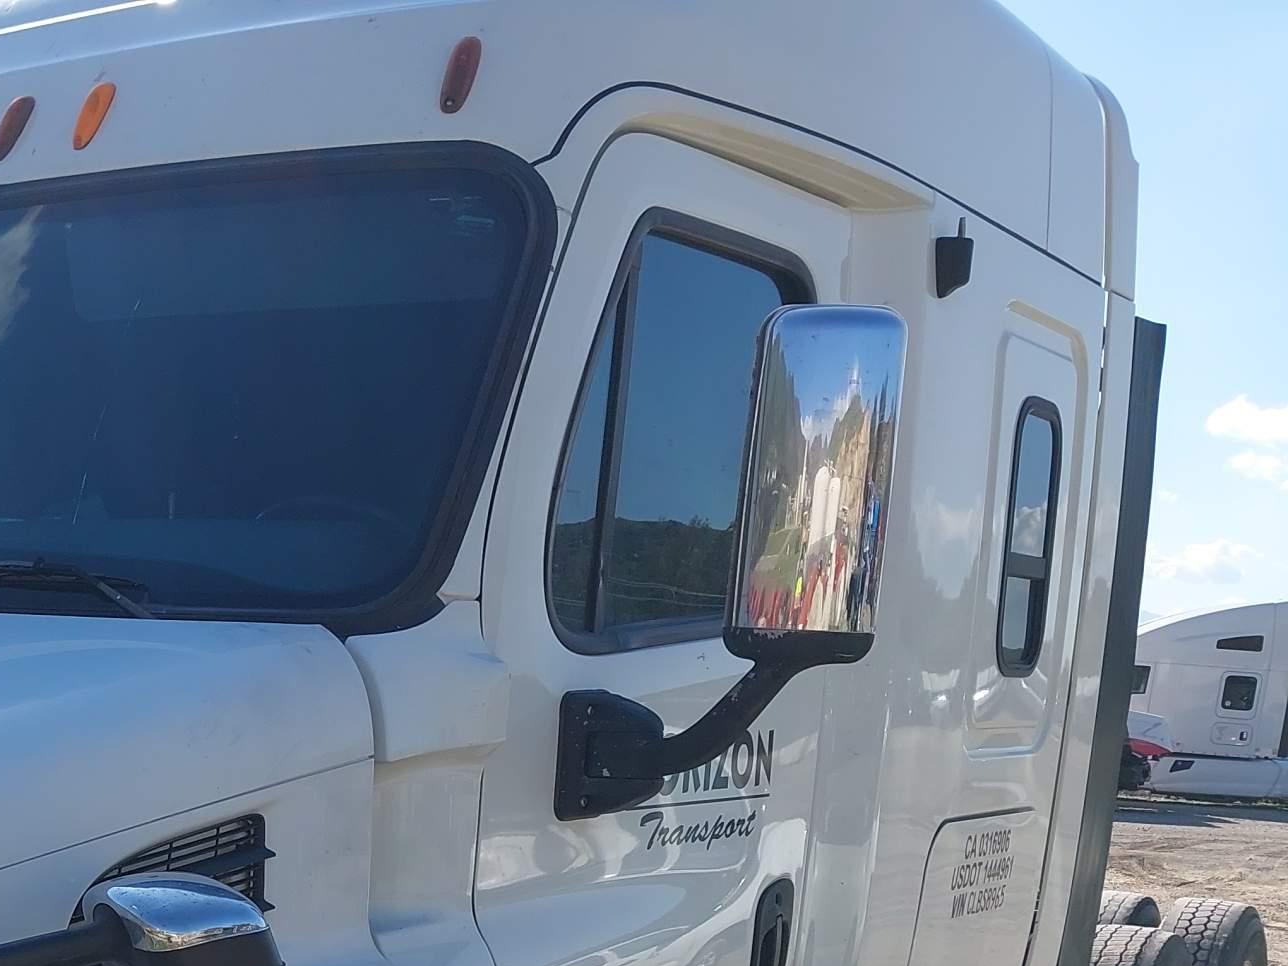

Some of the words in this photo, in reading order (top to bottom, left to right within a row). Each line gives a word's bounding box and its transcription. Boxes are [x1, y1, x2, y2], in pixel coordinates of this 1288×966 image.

[640, 810, 757, 850] Transport
[964, 834, 977, 860] CA
[951, 861, 983, 891] USDOT
[983, 855, 1015, 884] 1444961
[951, 892, 968, 919] VIN
